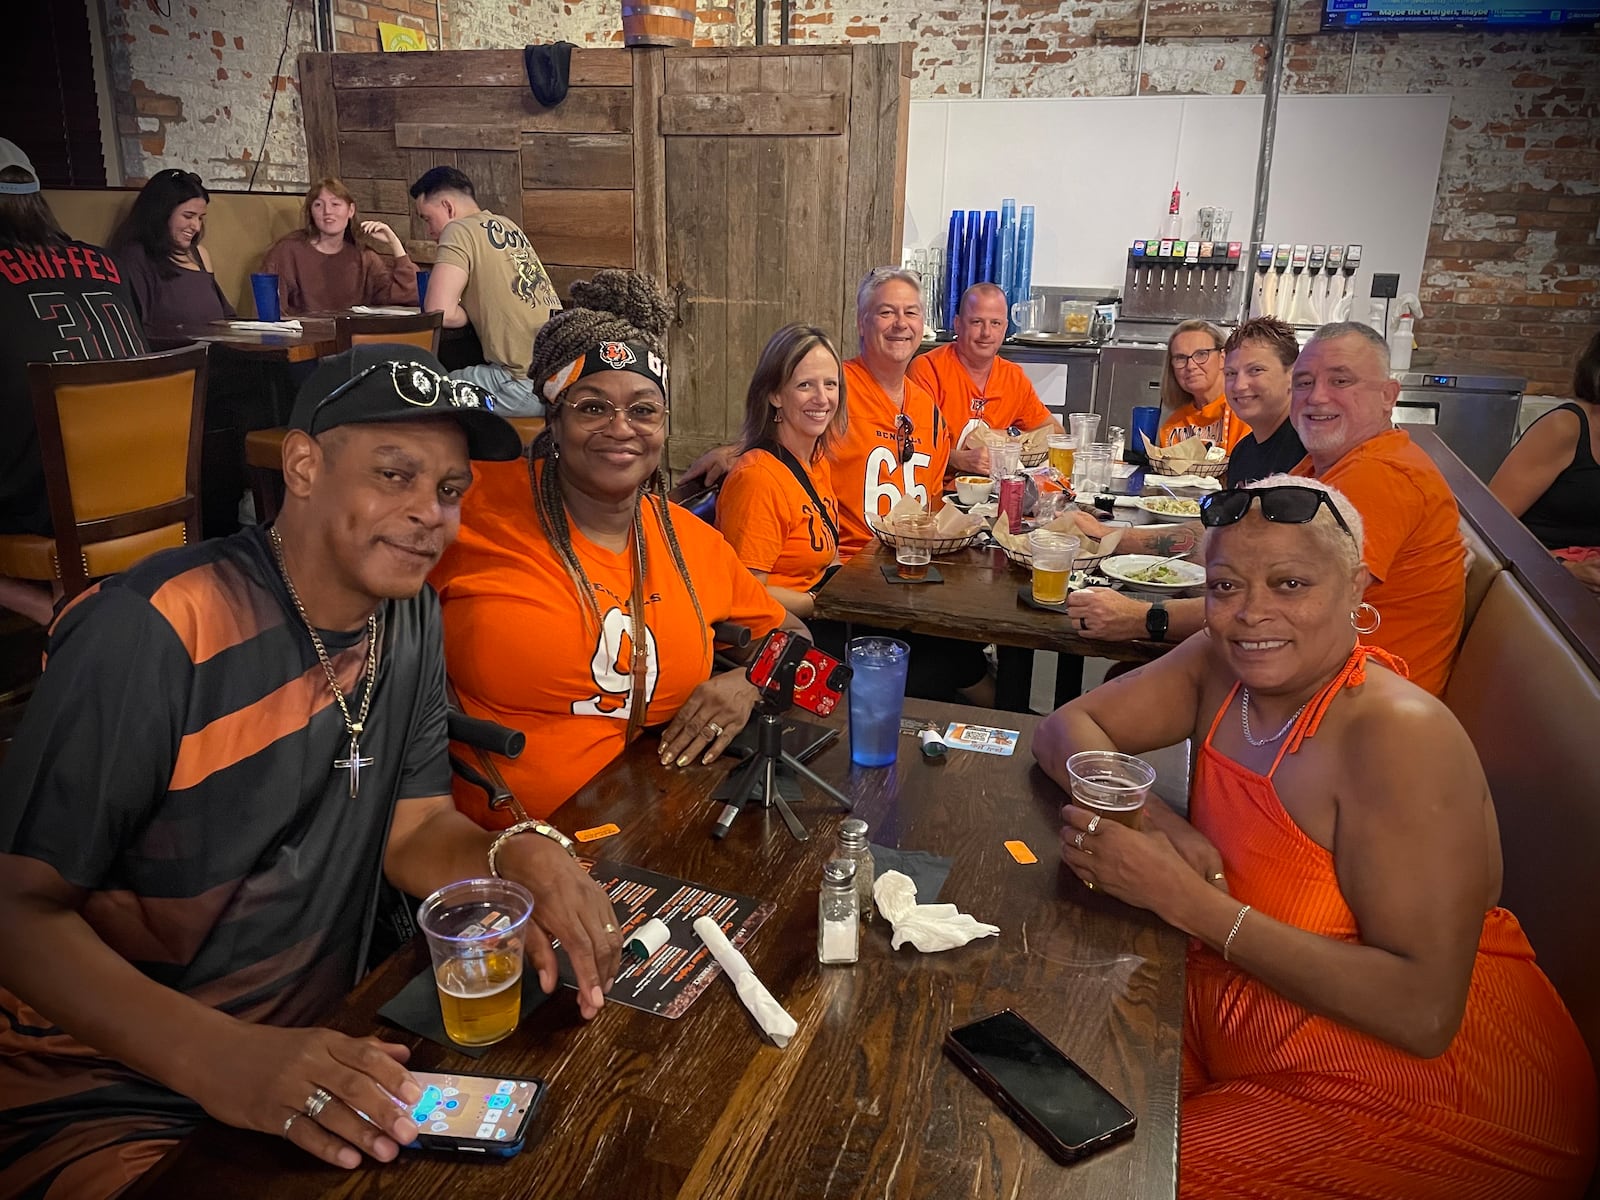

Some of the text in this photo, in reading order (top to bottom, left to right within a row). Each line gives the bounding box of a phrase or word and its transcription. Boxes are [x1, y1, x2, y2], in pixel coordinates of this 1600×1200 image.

[1379, 9, 1405, 17] Maybe
[1461, 9, 1488, 17] maybe
[0, 245, 121, 285] GRIFFEY
[864, 446, 932, 536] 65
[571, 606, 660, 720] 9
